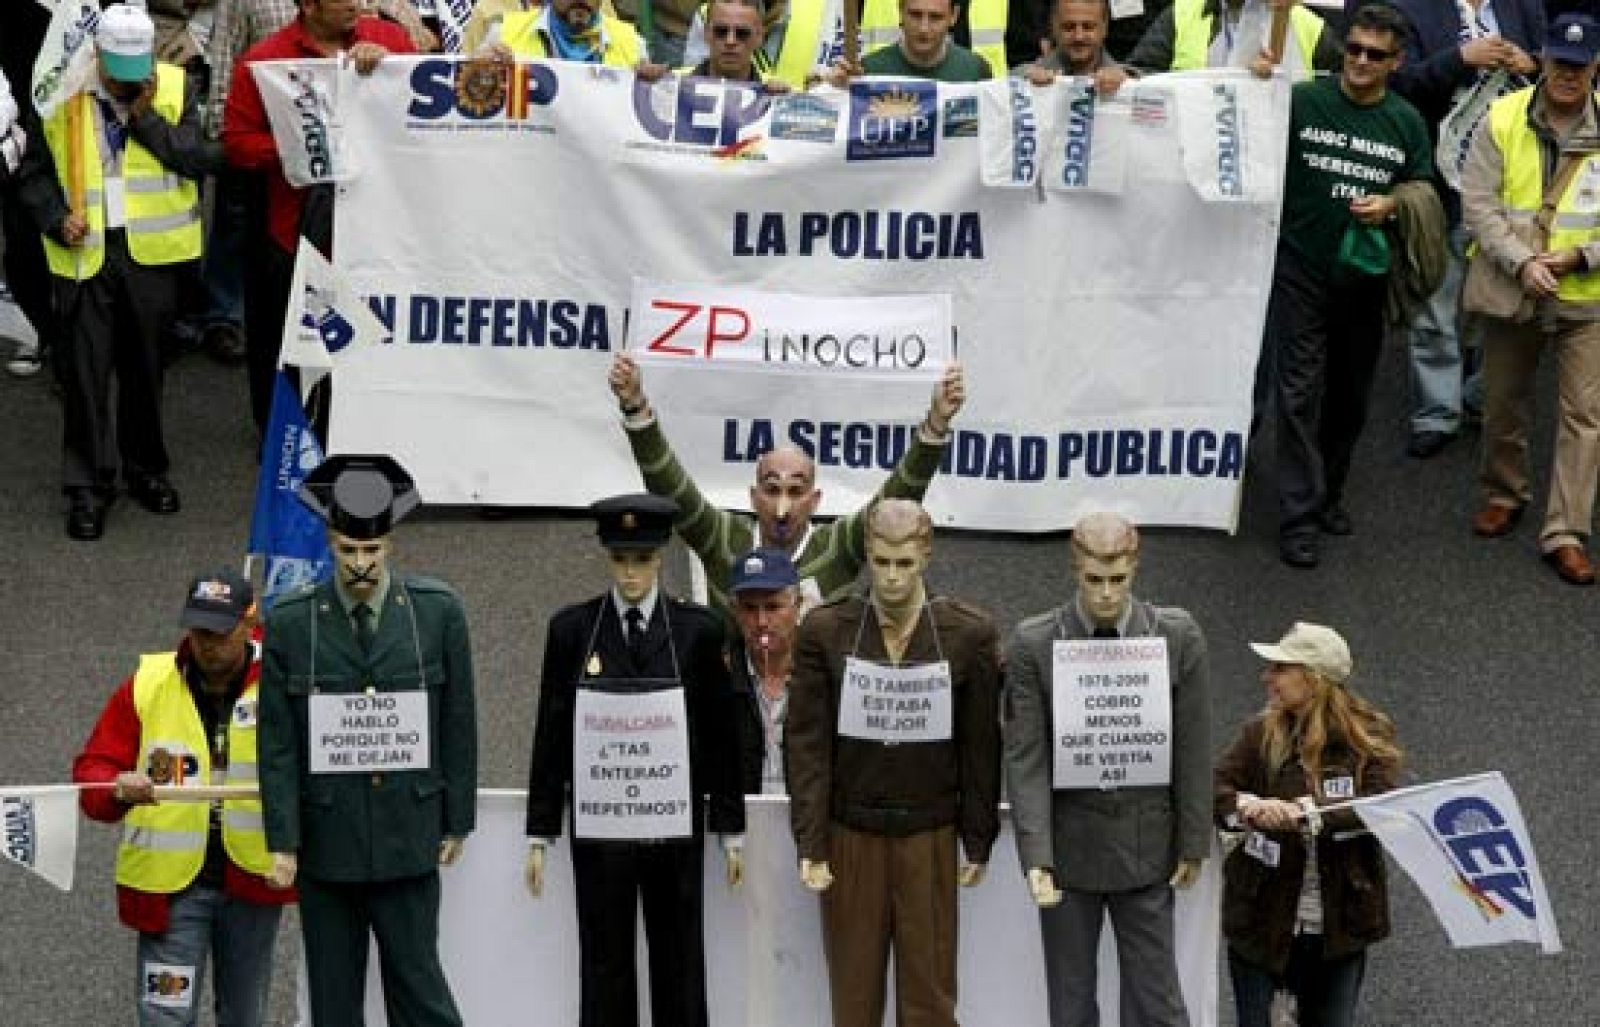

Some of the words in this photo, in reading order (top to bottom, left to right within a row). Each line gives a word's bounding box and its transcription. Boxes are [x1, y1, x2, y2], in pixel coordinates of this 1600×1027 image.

[630, 72, 771, 147] CEP
[732, 211, 788, 257] LA
[798, 209, 984, 260] POLICIA
[408, 294, 612, 352] DEFENSA
[723, 419, 775, 463] LA
[787, 419, 1048, 481] SEGUIDAD
[1057, 428, 1243, 481] PUBLICA
[344, 698, 367, 711] YO
[371, 698, 397, 711] NO
[862, 695, 932, 713] ESTABA
[1085, 695, 1142, 710] COBRO
[341, 714, 399, 729] HABLO
[866, 715, 926, 731] MEJOR
[1085, 714, 1141, 728] MENOS
[321, 732, 391, 748] PORQUE
[395, 731, 420, 746] NO
[1061, 733, 1094, 748] QUE
[1099, 732, 1167, 746] CUANDO
[328, 752, 354, 766] ME
[357, 750, 412, 766] DEJAN
[1073, 752, 1094, 766] SE
[624, 784, 641, 798] O
